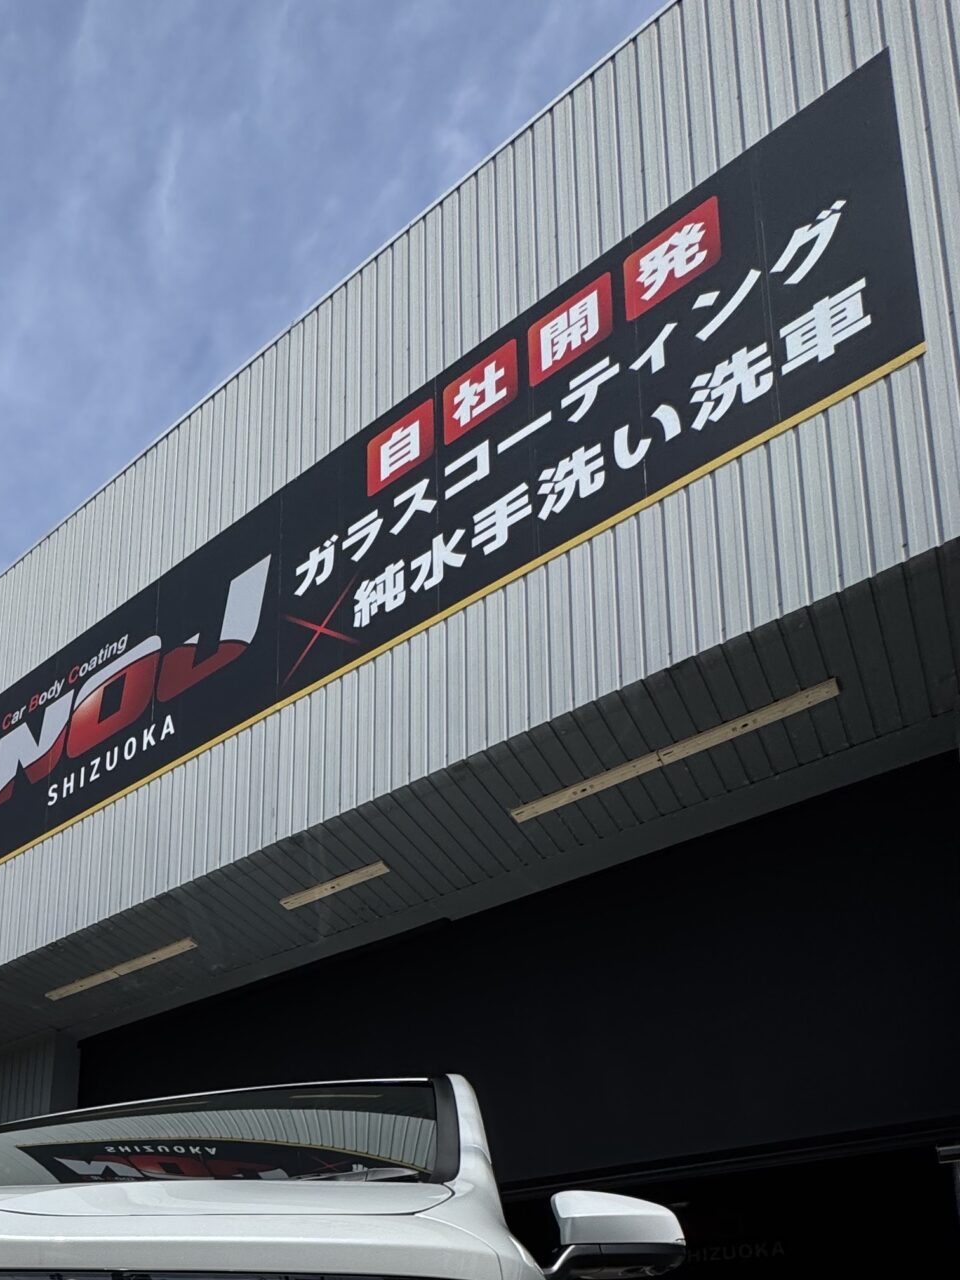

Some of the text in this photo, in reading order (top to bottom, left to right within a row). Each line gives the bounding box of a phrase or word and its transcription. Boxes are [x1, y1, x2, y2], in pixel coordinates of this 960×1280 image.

[294, 199, 847, 597] ガラスコーティング
[379, 221, 708, 482] 自社開発
[353, 277, 872, 628] 純水手洗い洗車
[2, 634, 128, 730] Car Body Coating
[47, 714, 175, 806] SHIZUOKA
[687, 1241, 785, 1263] HIZUOKA
